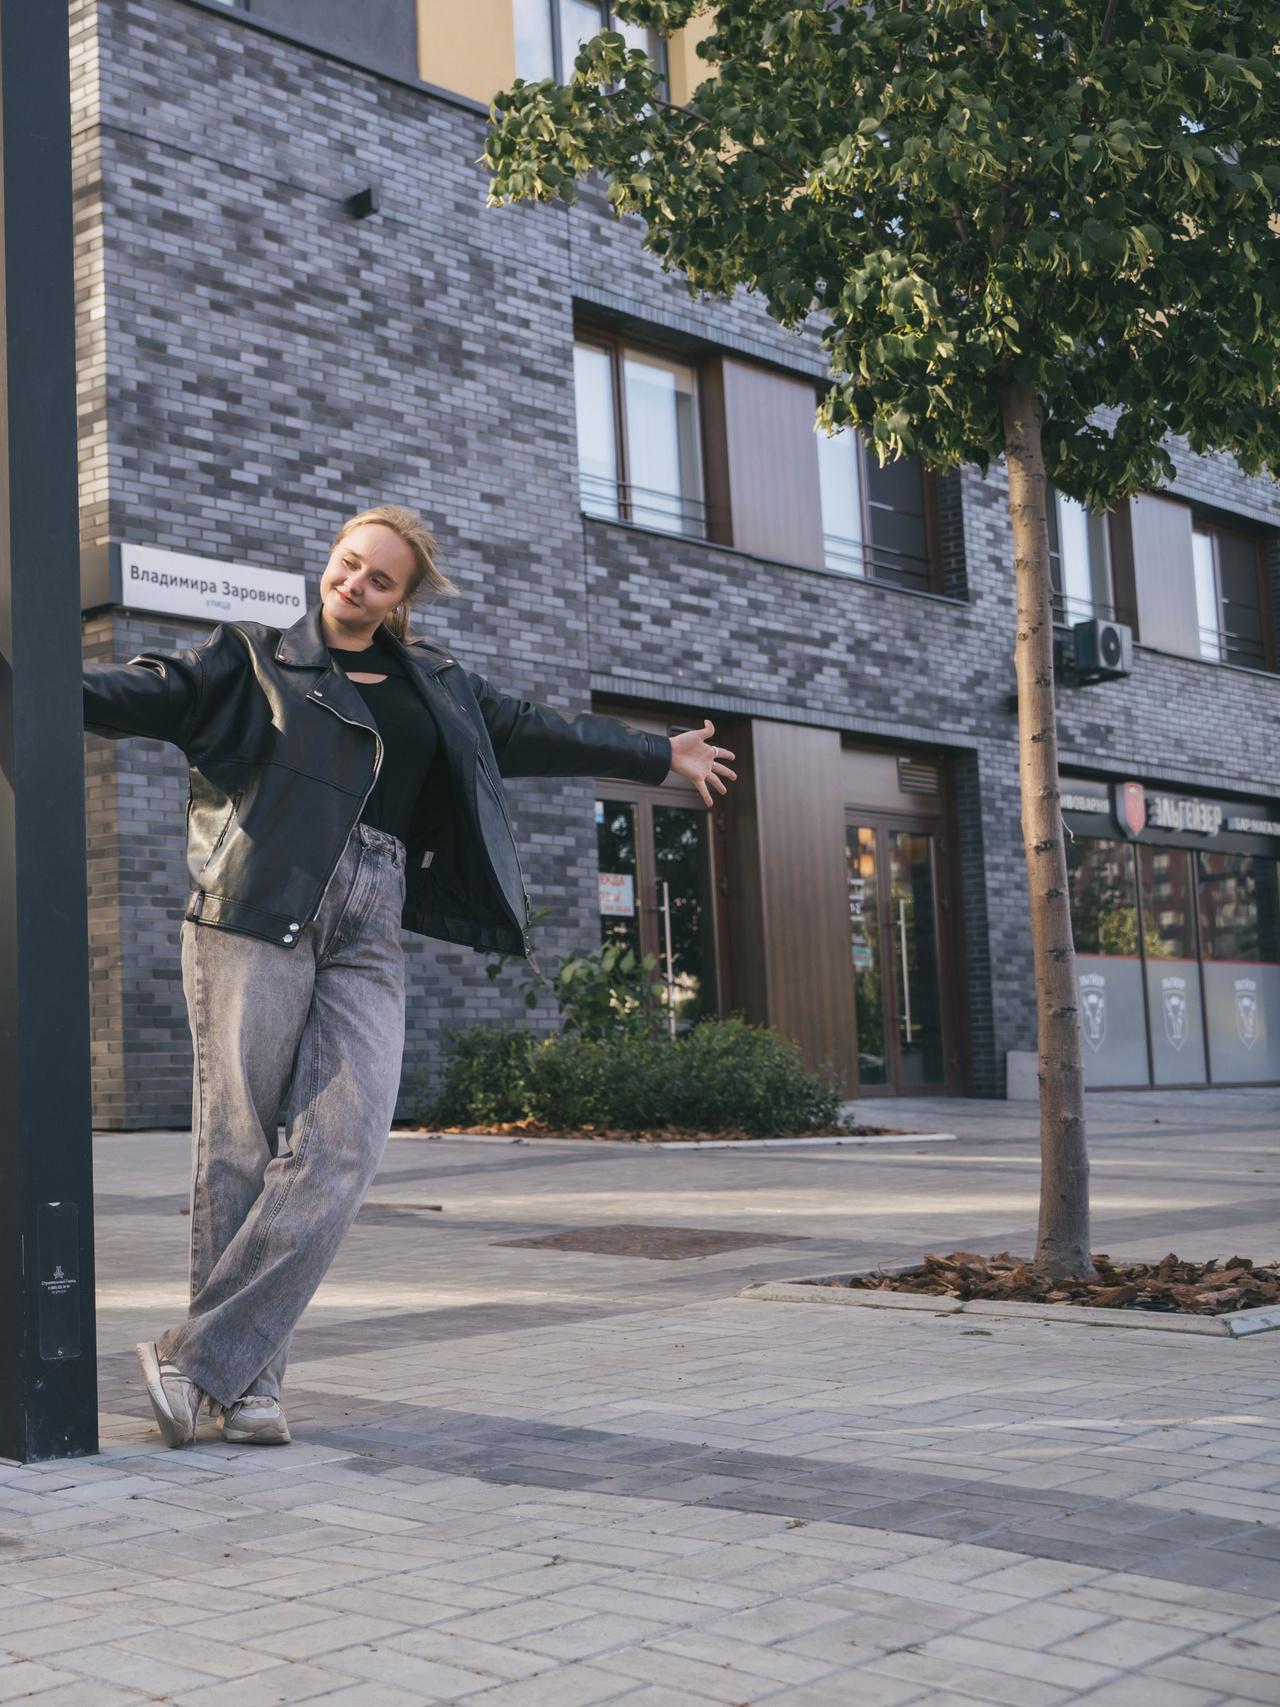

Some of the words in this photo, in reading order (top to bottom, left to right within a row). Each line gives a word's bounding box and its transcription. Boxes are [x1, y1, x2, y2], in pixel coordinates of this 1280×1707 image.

[130, 565, 217, 595] Владимира
[222, 581, 300, 607] Заровного
[205, 599, 232, 610] улица
